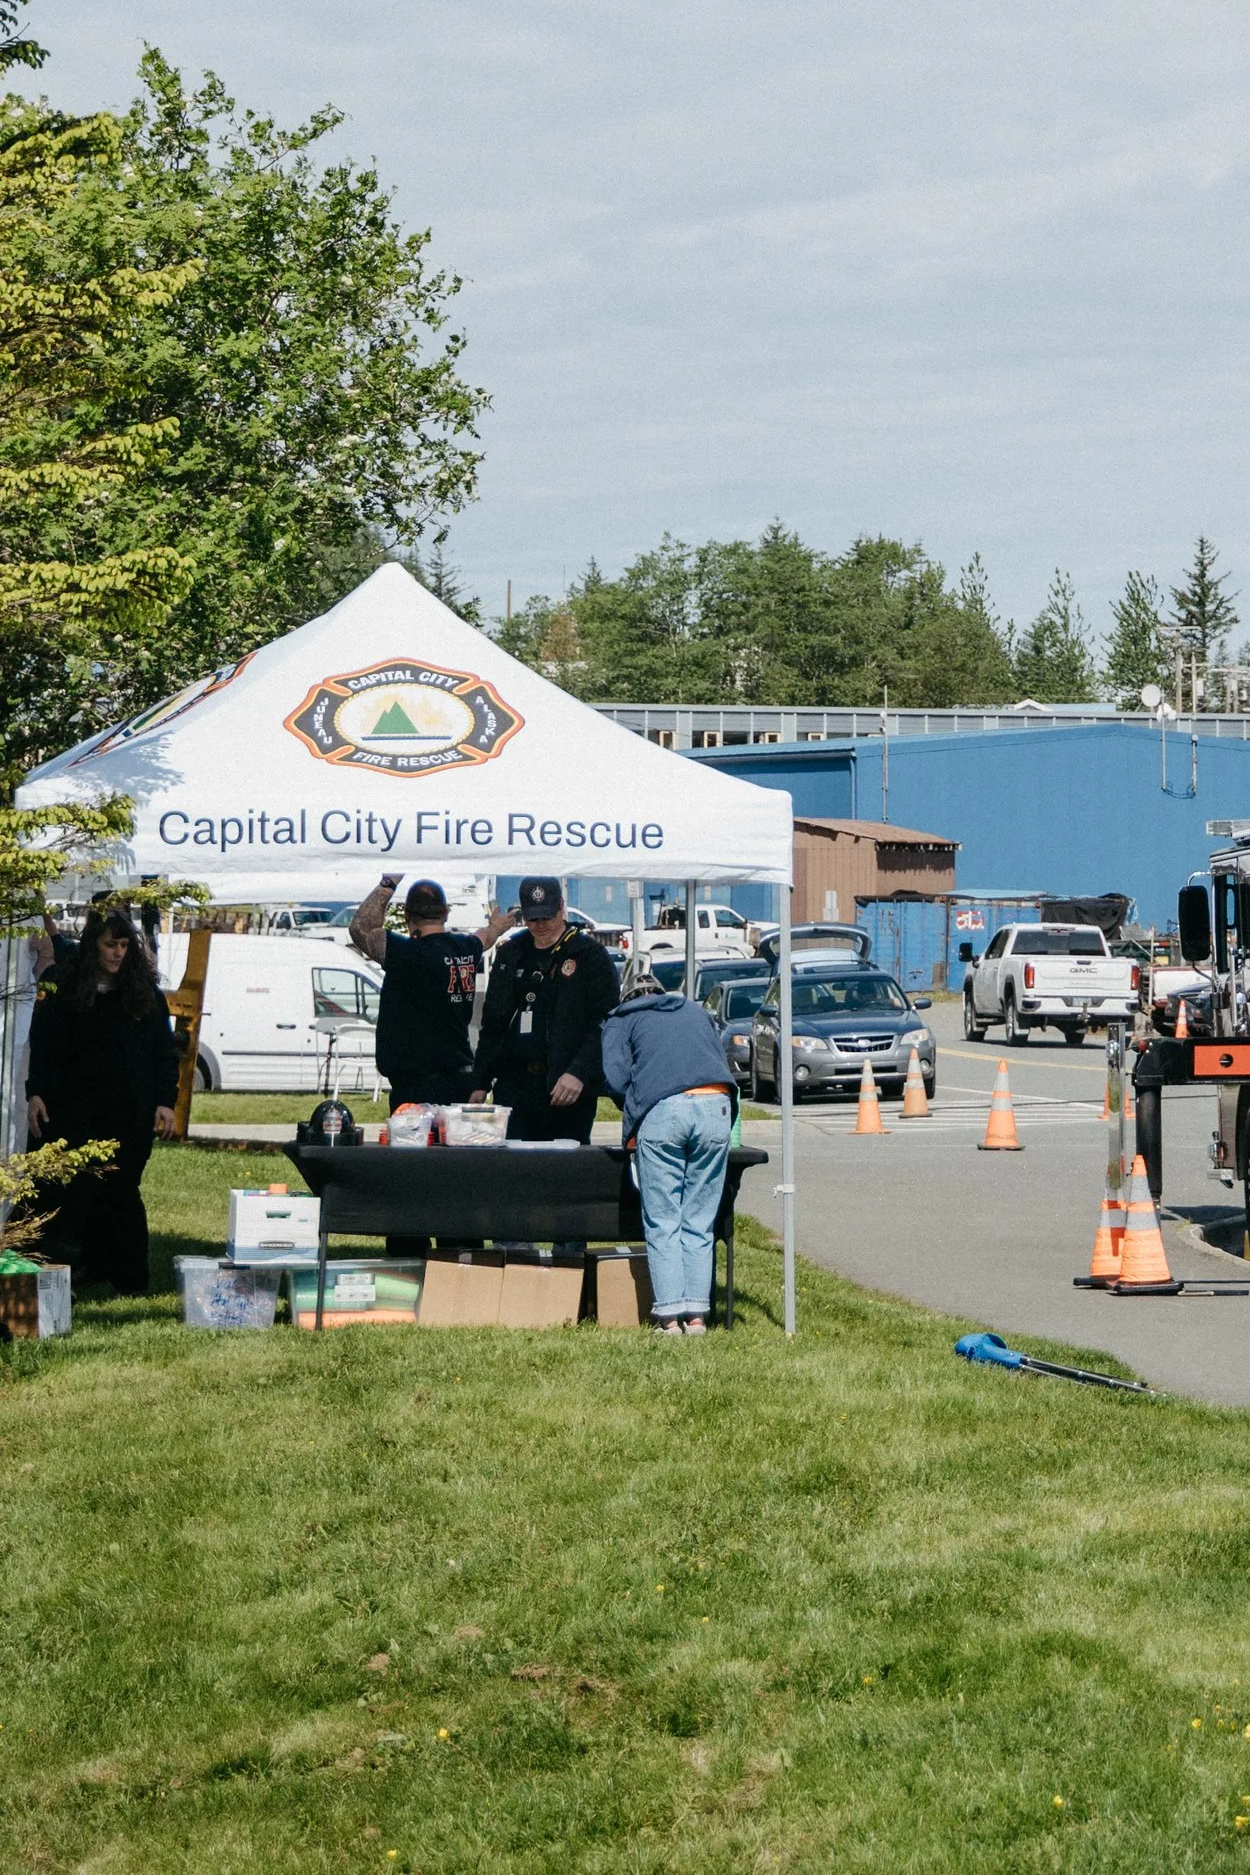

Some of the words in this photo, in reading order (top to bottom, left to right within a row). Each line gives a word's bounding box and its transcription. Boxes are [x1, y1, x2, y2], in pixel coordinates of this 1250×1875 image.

[348, 670, 415, 690] CAPITAL
[419, 671, 459, 688] CITY
[314, 697, 333, 744] JUNEAU
[475, 696, 497, 743] ALASKA
[352, 751, 393, 766] FIRE
[398, 750, 463, 767] RESCUE
[159, 808, 306, 853] Capital
[321, 808, 403, 852] City
[416, 810, 493, 845] Fire
[507, 812, 664, 849] Rescue
